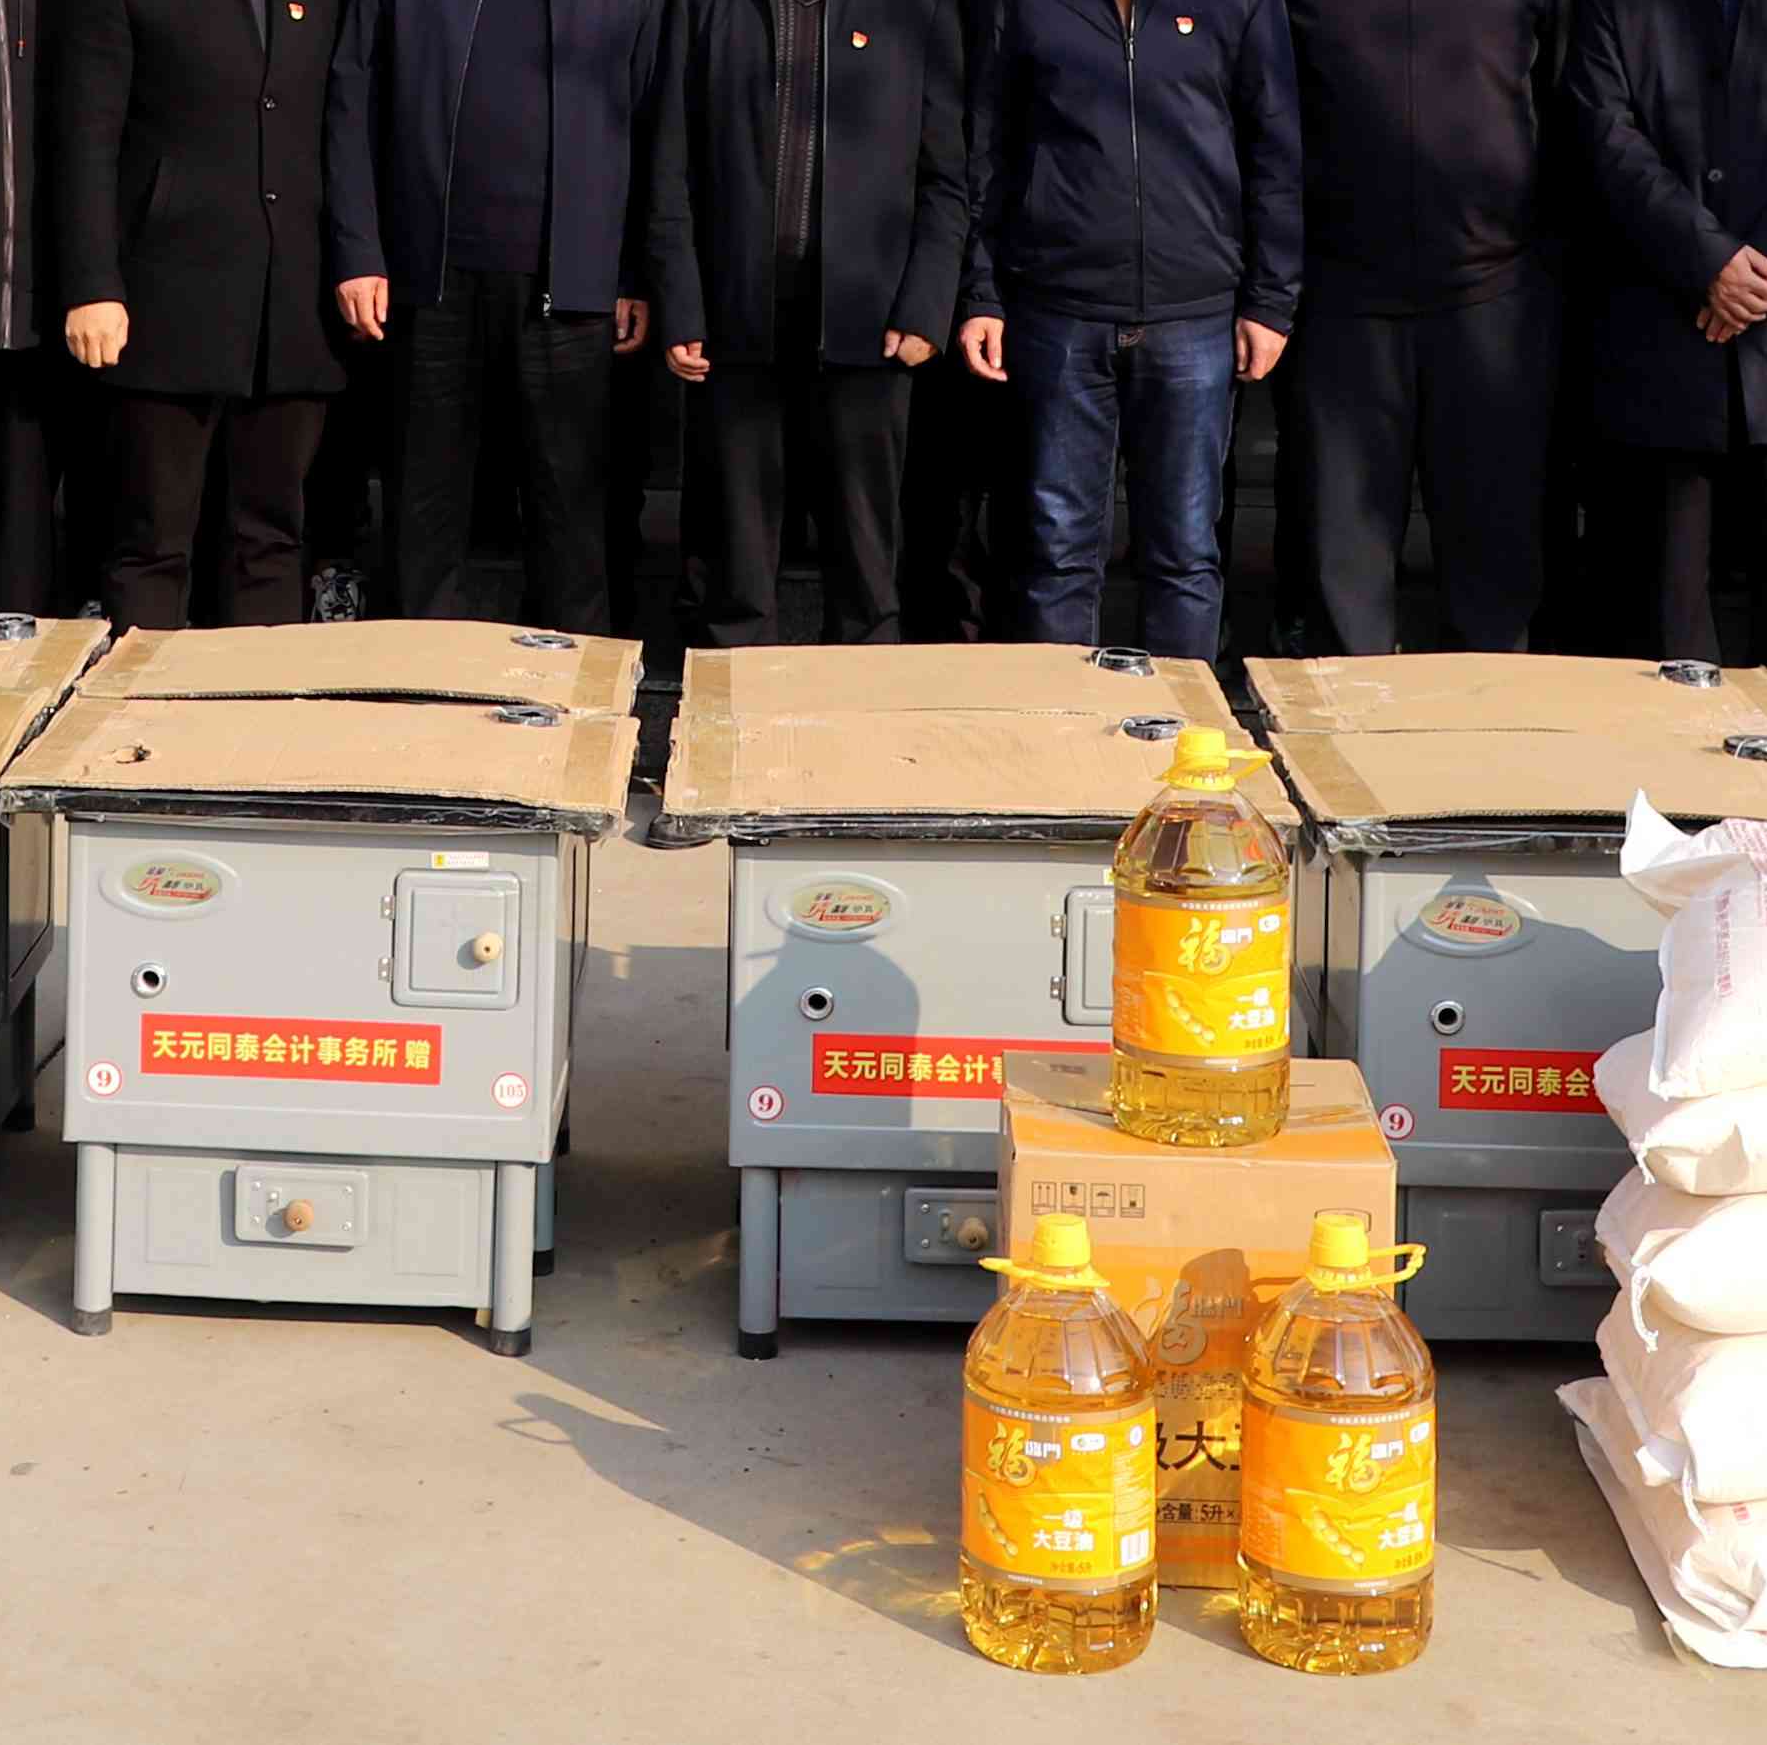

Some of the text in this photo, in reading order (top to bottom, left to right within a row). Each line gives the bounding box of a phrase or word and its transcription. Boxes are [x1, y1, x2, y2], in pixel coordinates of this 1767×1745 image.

[152, 1029, 431, 1070] 天元同泰会计事务所 赠
[823, 1051, 1002, 1084] 天元同泰会计
[96, 1069, 112, 1088] 9
[1451, 1065, 1590, 1097] 天元同泰会
[498, 1083, 524, 1100] 105
[758, 1093, 774, 1112] 9
[1388, 1113, 1405, 1131] 9
